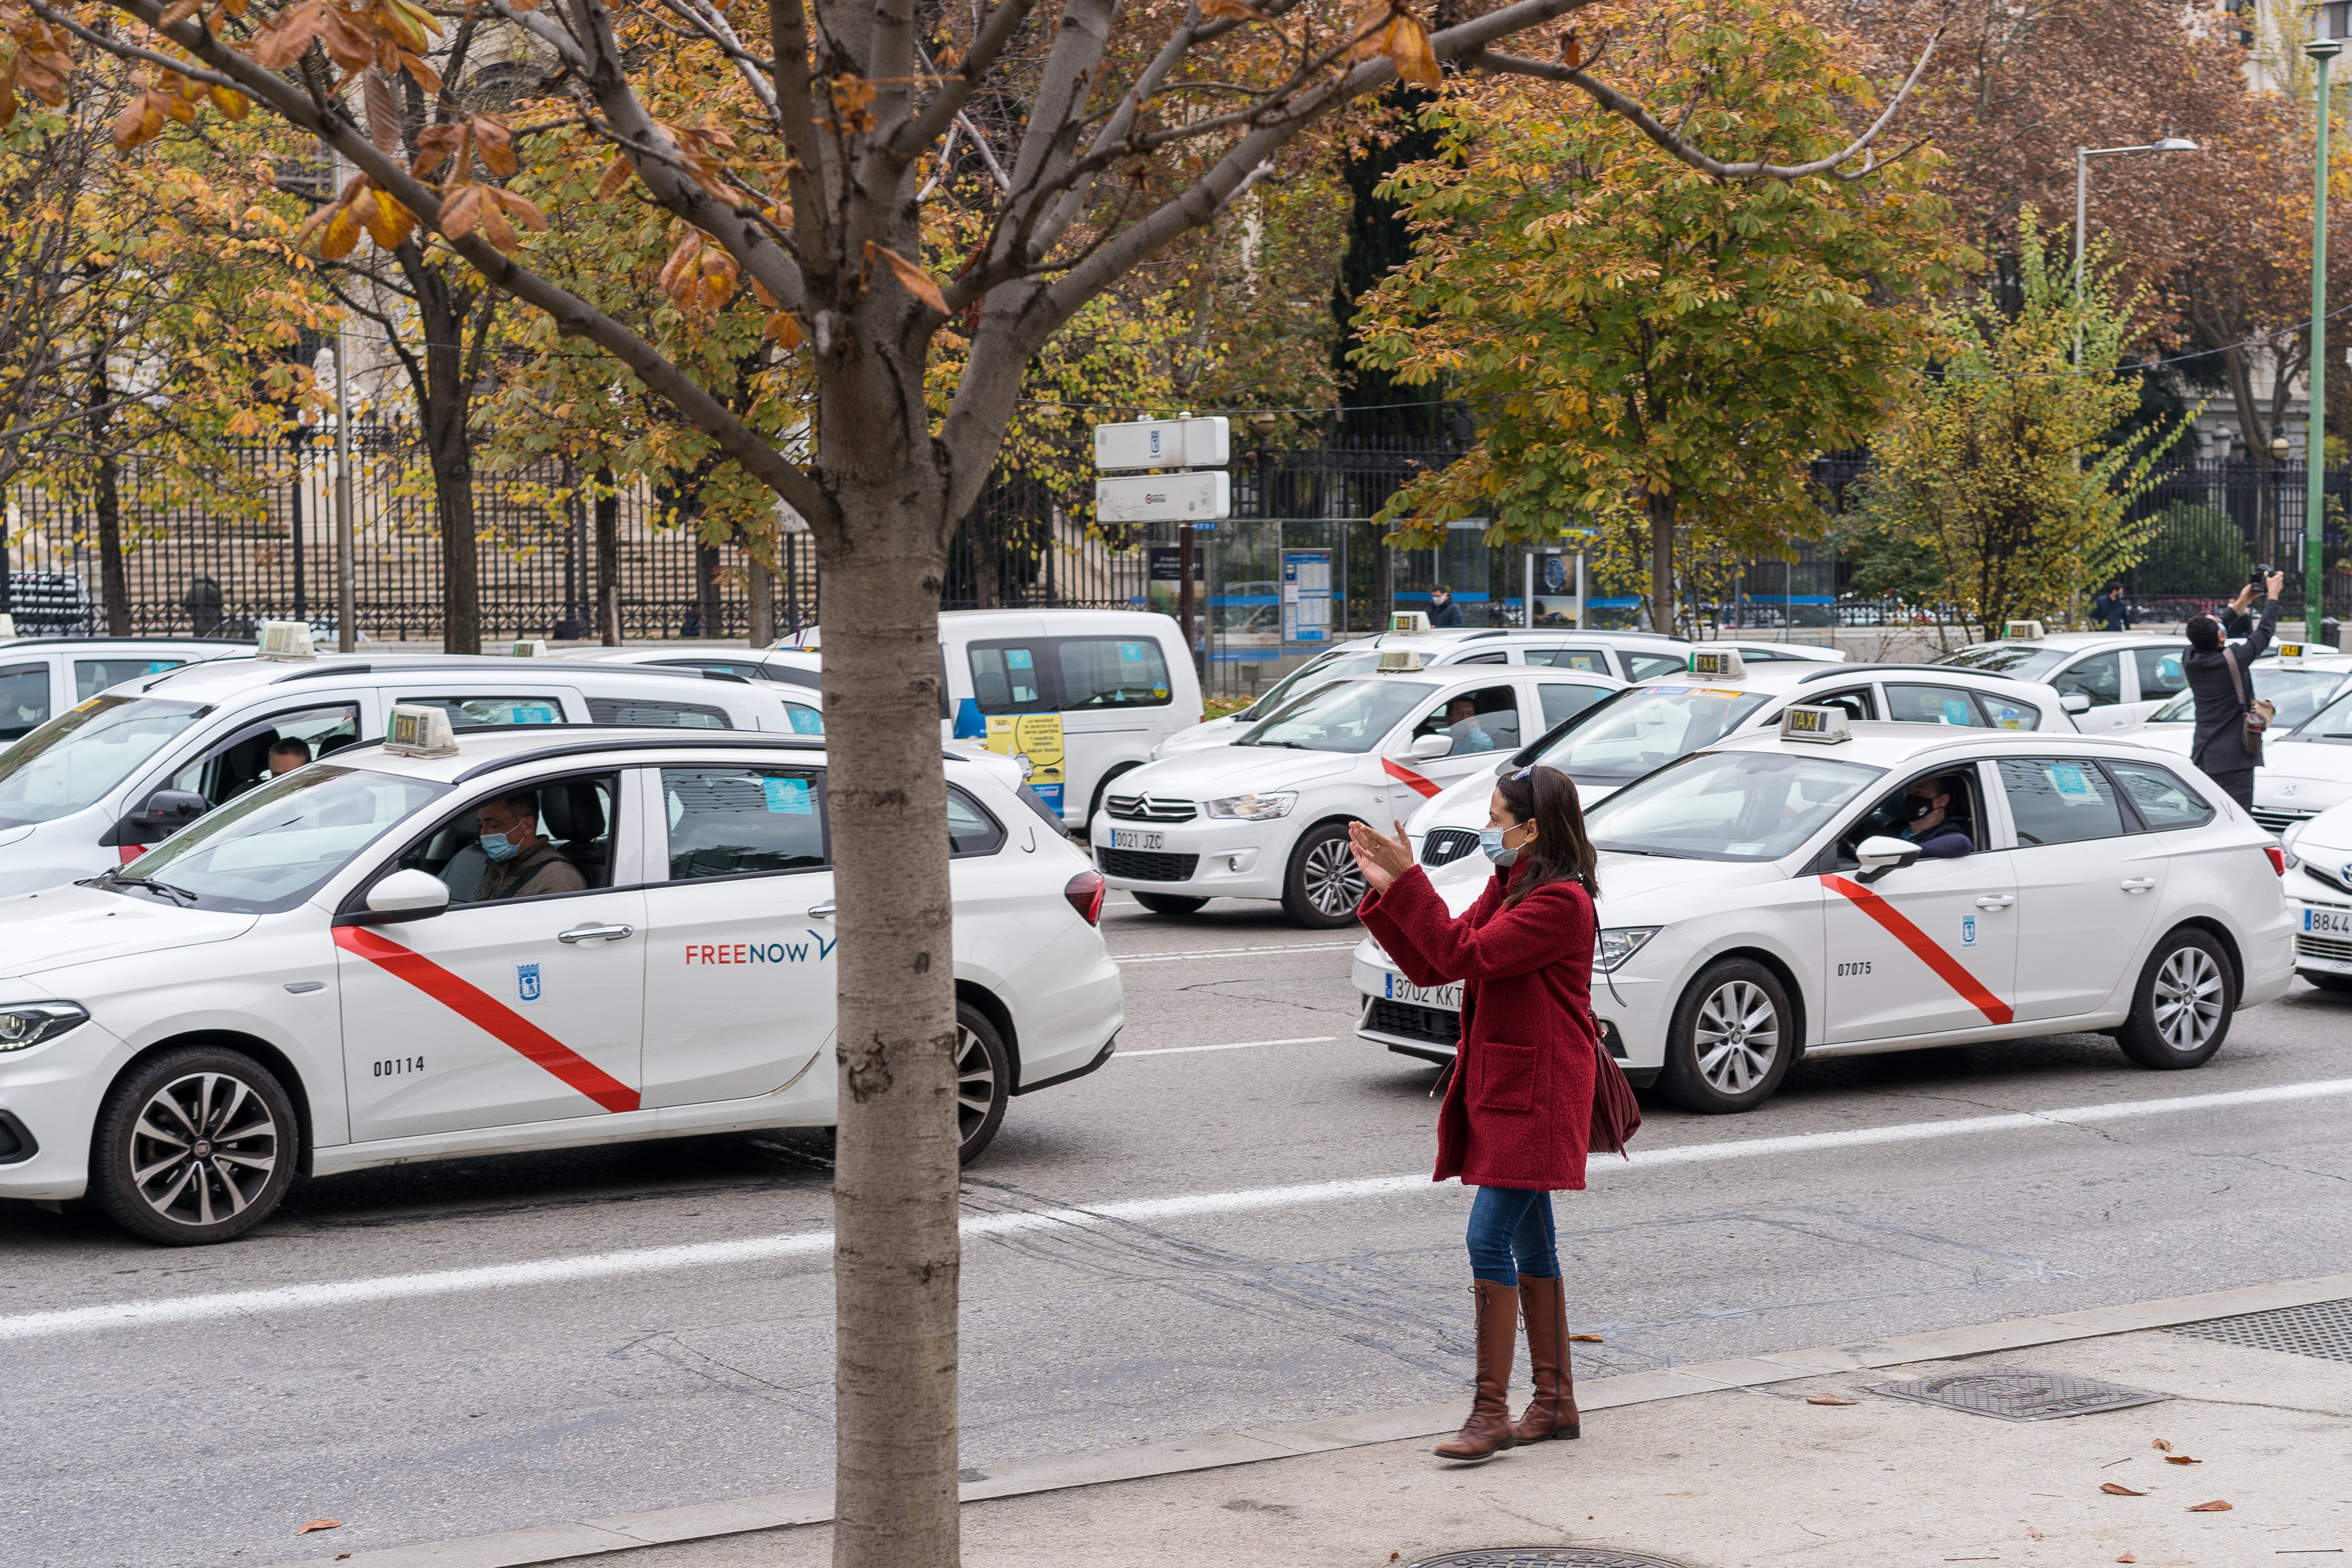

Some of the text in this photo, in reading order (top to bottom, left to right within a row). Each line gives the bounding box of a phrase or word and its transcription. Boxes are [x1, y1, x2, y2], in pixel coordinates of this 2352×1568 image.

[2282, 645, 2298, 656] TAXI
[1698, 656, 1717, 670] TAXI
[397, 718, 416, 741] TAXI
[1793, 711, 1817, 730] TAXI
[1116, 832, 1161, 849] 0021 JZC
[2313, 913, 2350, 933] 8844
[1837, 962, 1872, 977] 07075
[1396, 979, 1430, 1003] 3702
[1436, 985, 1463, 1008] KKT
[373, 1056, 424, 1078] 00114
